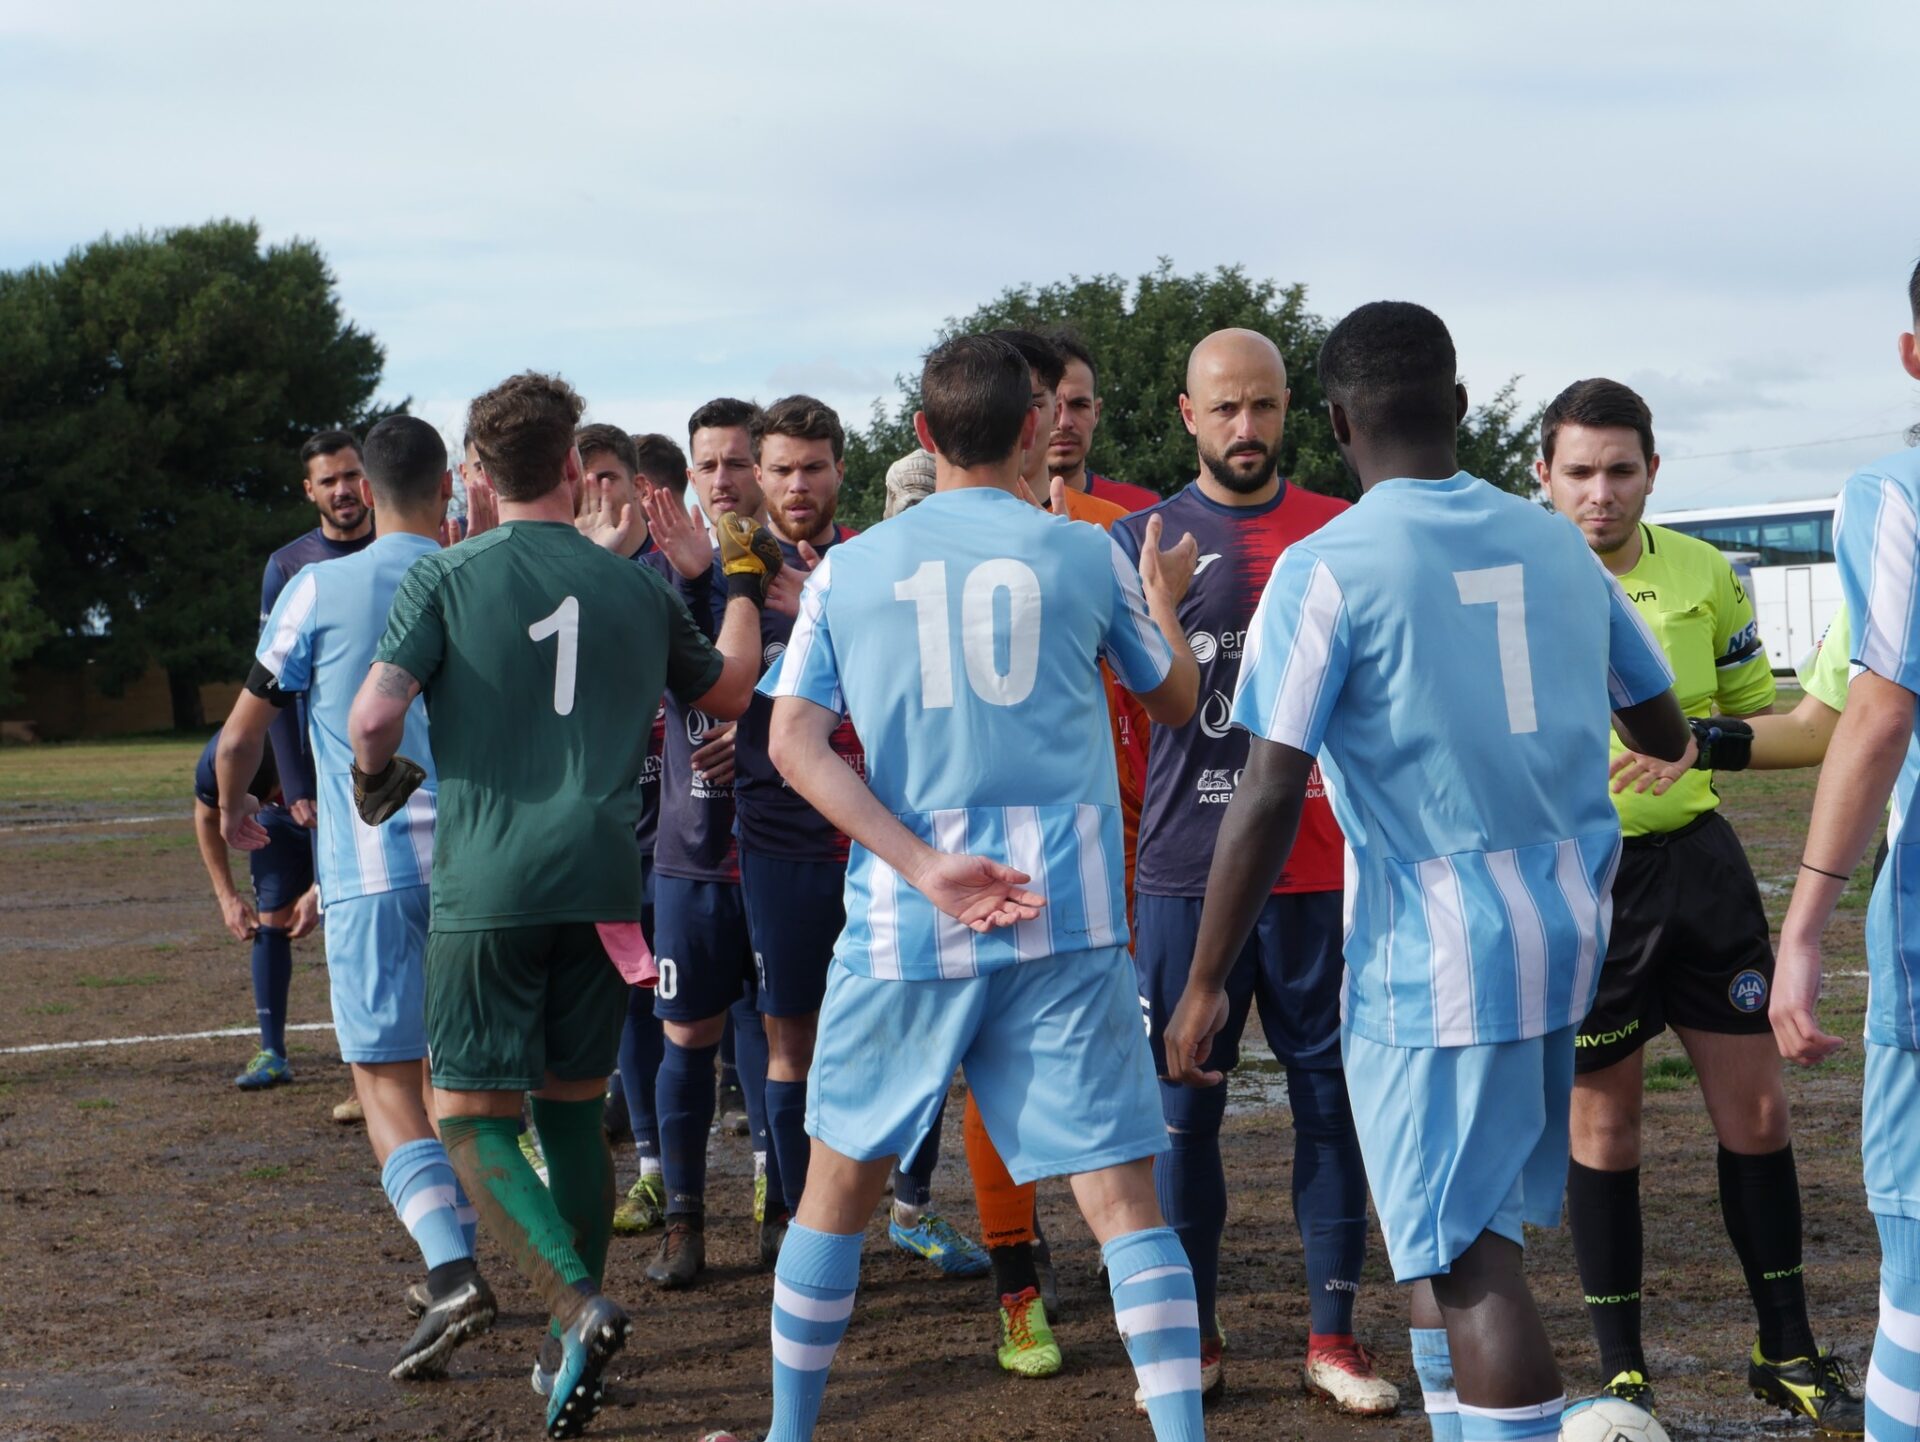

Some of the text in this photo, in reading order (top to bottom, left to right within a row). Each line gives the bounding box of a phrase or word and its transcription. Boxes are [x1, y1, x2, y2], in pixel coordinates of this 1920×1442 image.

[1626, 590, 1657, 603] VA
[529, 596, 579, 716] 1
[895, 558, 1042, 709] 10
[1453, 564, 1538, 734] 7
[1737, 981, 1762, 998] AIA
[1584, 1291, 1640, 1304] GIVOVA
